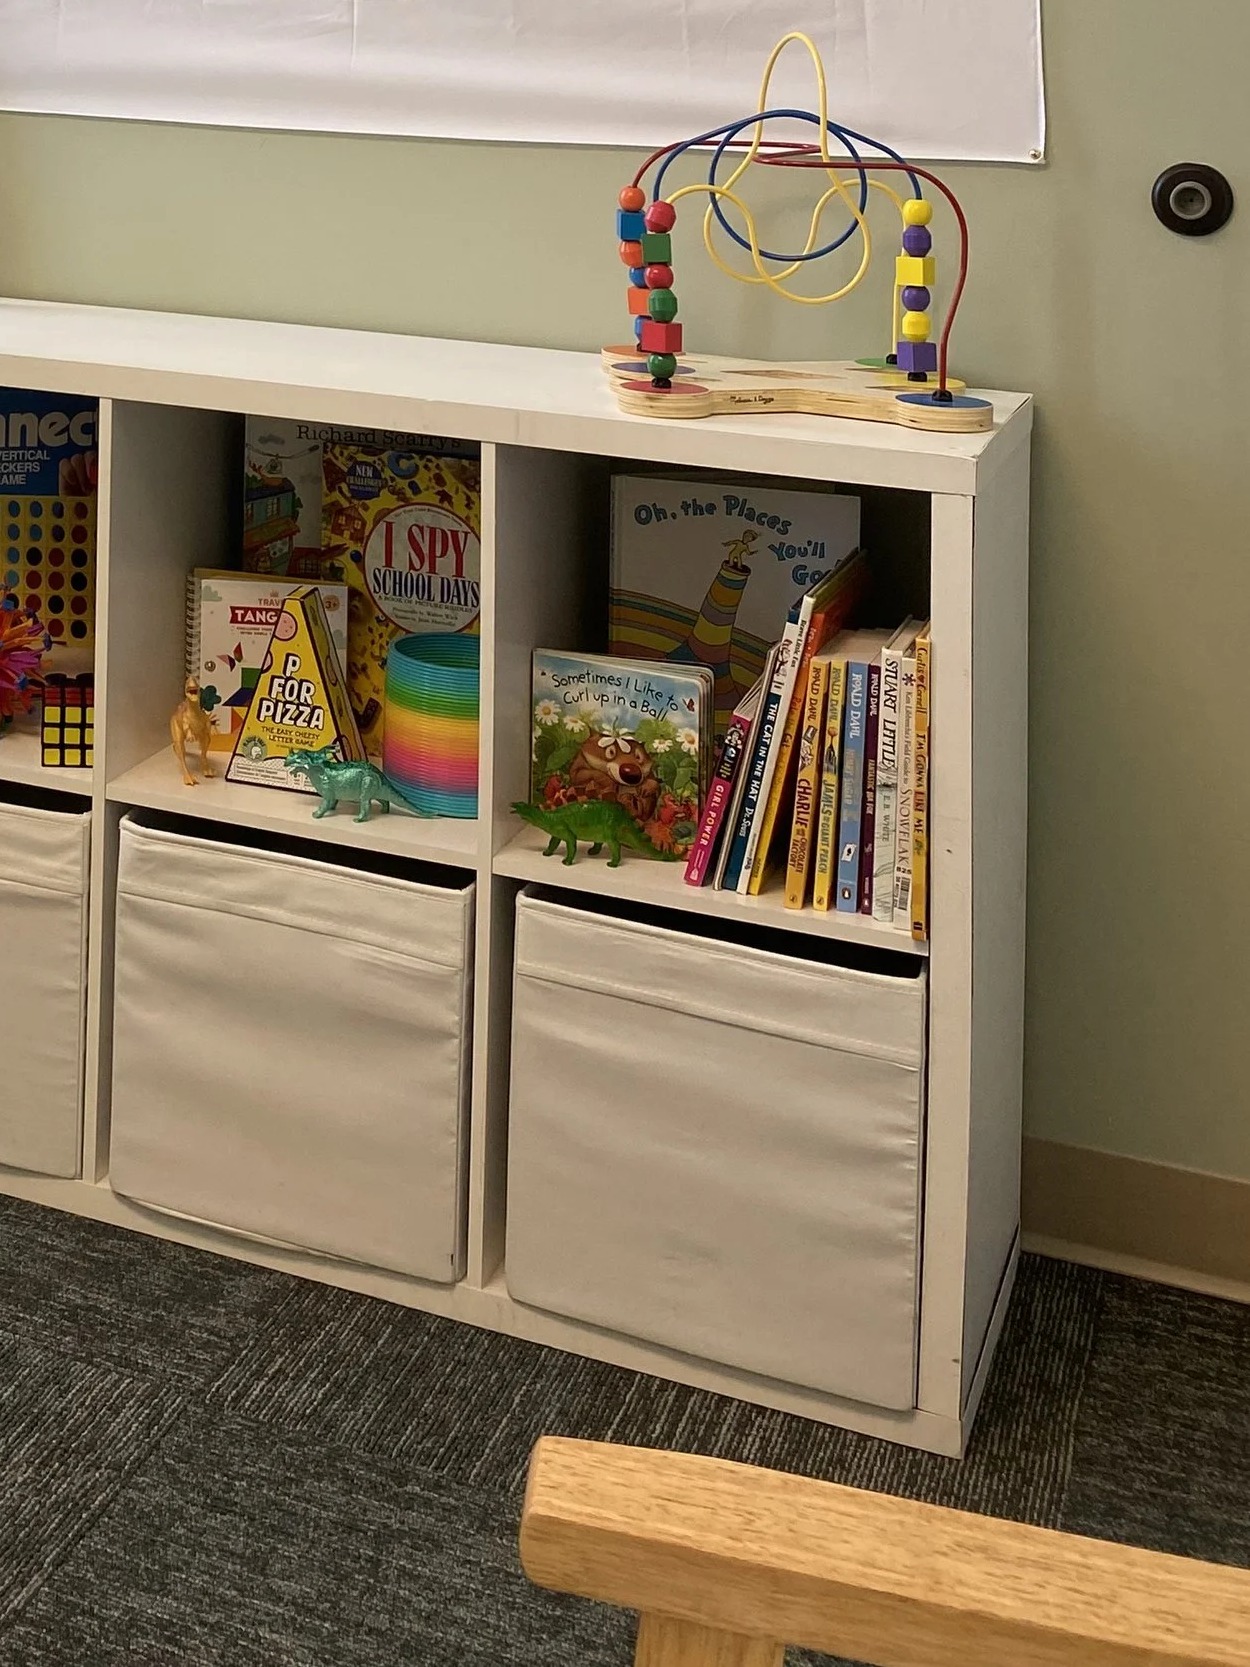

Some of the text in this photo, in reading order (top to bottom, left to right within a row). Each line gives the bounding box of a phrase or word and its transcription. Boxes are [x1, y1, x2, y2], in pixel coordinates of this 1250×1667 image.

[296, 425, 376, 444] Richard
[634, 495, 792, 535] Oh, the Places
[382, 520, 471, 579] I SPY
[768, 540, 826, 561] You'll
[372, 568, 480, 608] SCHOOL DAYS
[792, 562, 836, 585] Go
[235, 610, 278, 623] TANG
[325, 600, 337, 608] 3+
[284, 653, 301, 677] P
[269, 675, 316, 705] FOR
[551, 669, 679, 711] Sometimes Like to
[563, 687, 668, 722] Curl up in Ball
[807, 667, 821, 722] ROALD DAHL
[829, 667, 841, 723] ROALD DAHL
[257, 698, 325, 731] PIZZA
[766, 703, 778, 721] THE
[850, 672, 863, 739] ROALD DAHL
[882, 658, 898, 770] STUART LITTLE
[261, 725, 320, 740] THE EASY CHEESY
[269, 735, 295, 745] LETTER
[295, 737, 315, 748] GAME
[761, 724, 773, 748] CAT
[758, 746, 768, 758] IN
[753, 760, 764, 777] THE
[749, 780, 760, 802] HAT
[914, 734, 926, 834] I'M GONNA LIKE ME
[700, 785, 724, 846] GIRL POWER
[796, 778, 812, 874] CHARLIE CHOCOLATE
[818, 779, 835, 874] JAMES GIANT PEACH
[882, 814, 891, 842] WHITE
